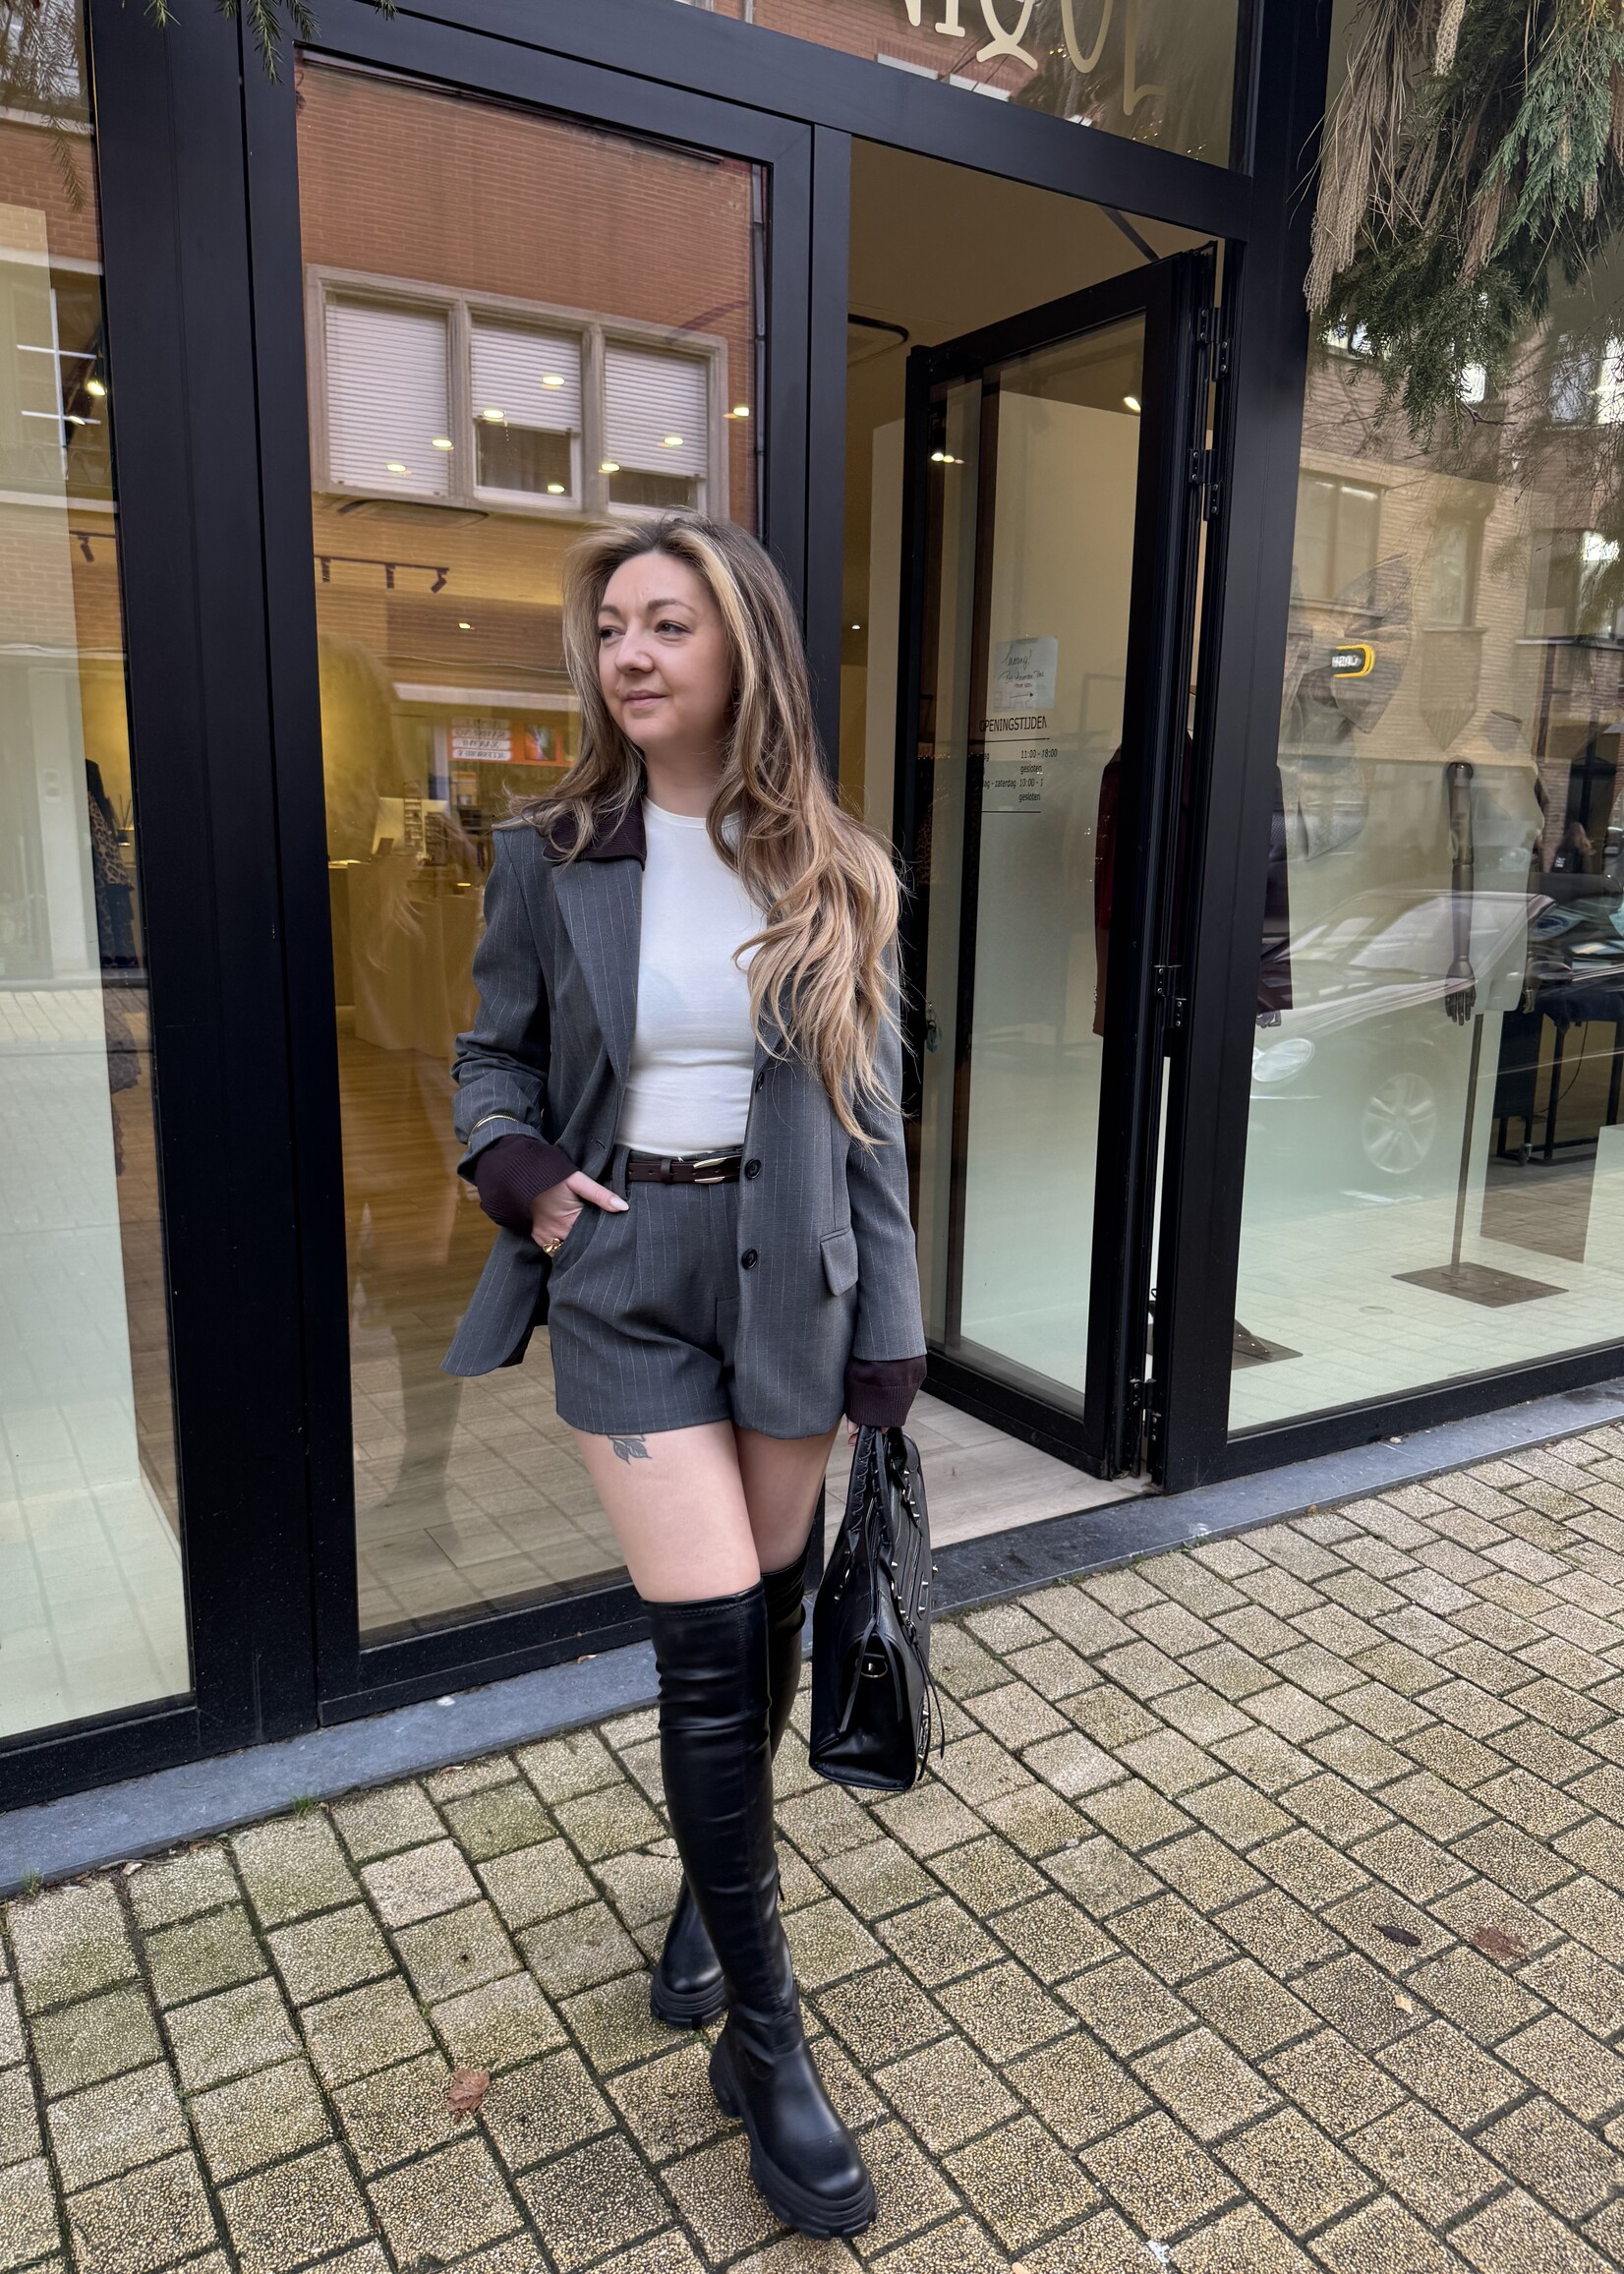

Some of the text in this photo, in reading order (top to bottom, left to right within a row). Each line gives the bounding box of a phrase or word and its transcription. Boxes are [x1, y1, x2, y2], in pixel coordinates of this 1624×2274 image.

[979, 715, 1048, 732] OPENINGSTIJDEN
[1021, 749, 1037, 759] 11:00
[1041, 748, 1058, 758] 18:00
[1020, 765, 1043, 775] gesloten
[995, 779, 1016, 789] zaterdag
[1019, 778, 1035, 787] 10:00
[1018, 792, 1041, 803] gesloten
